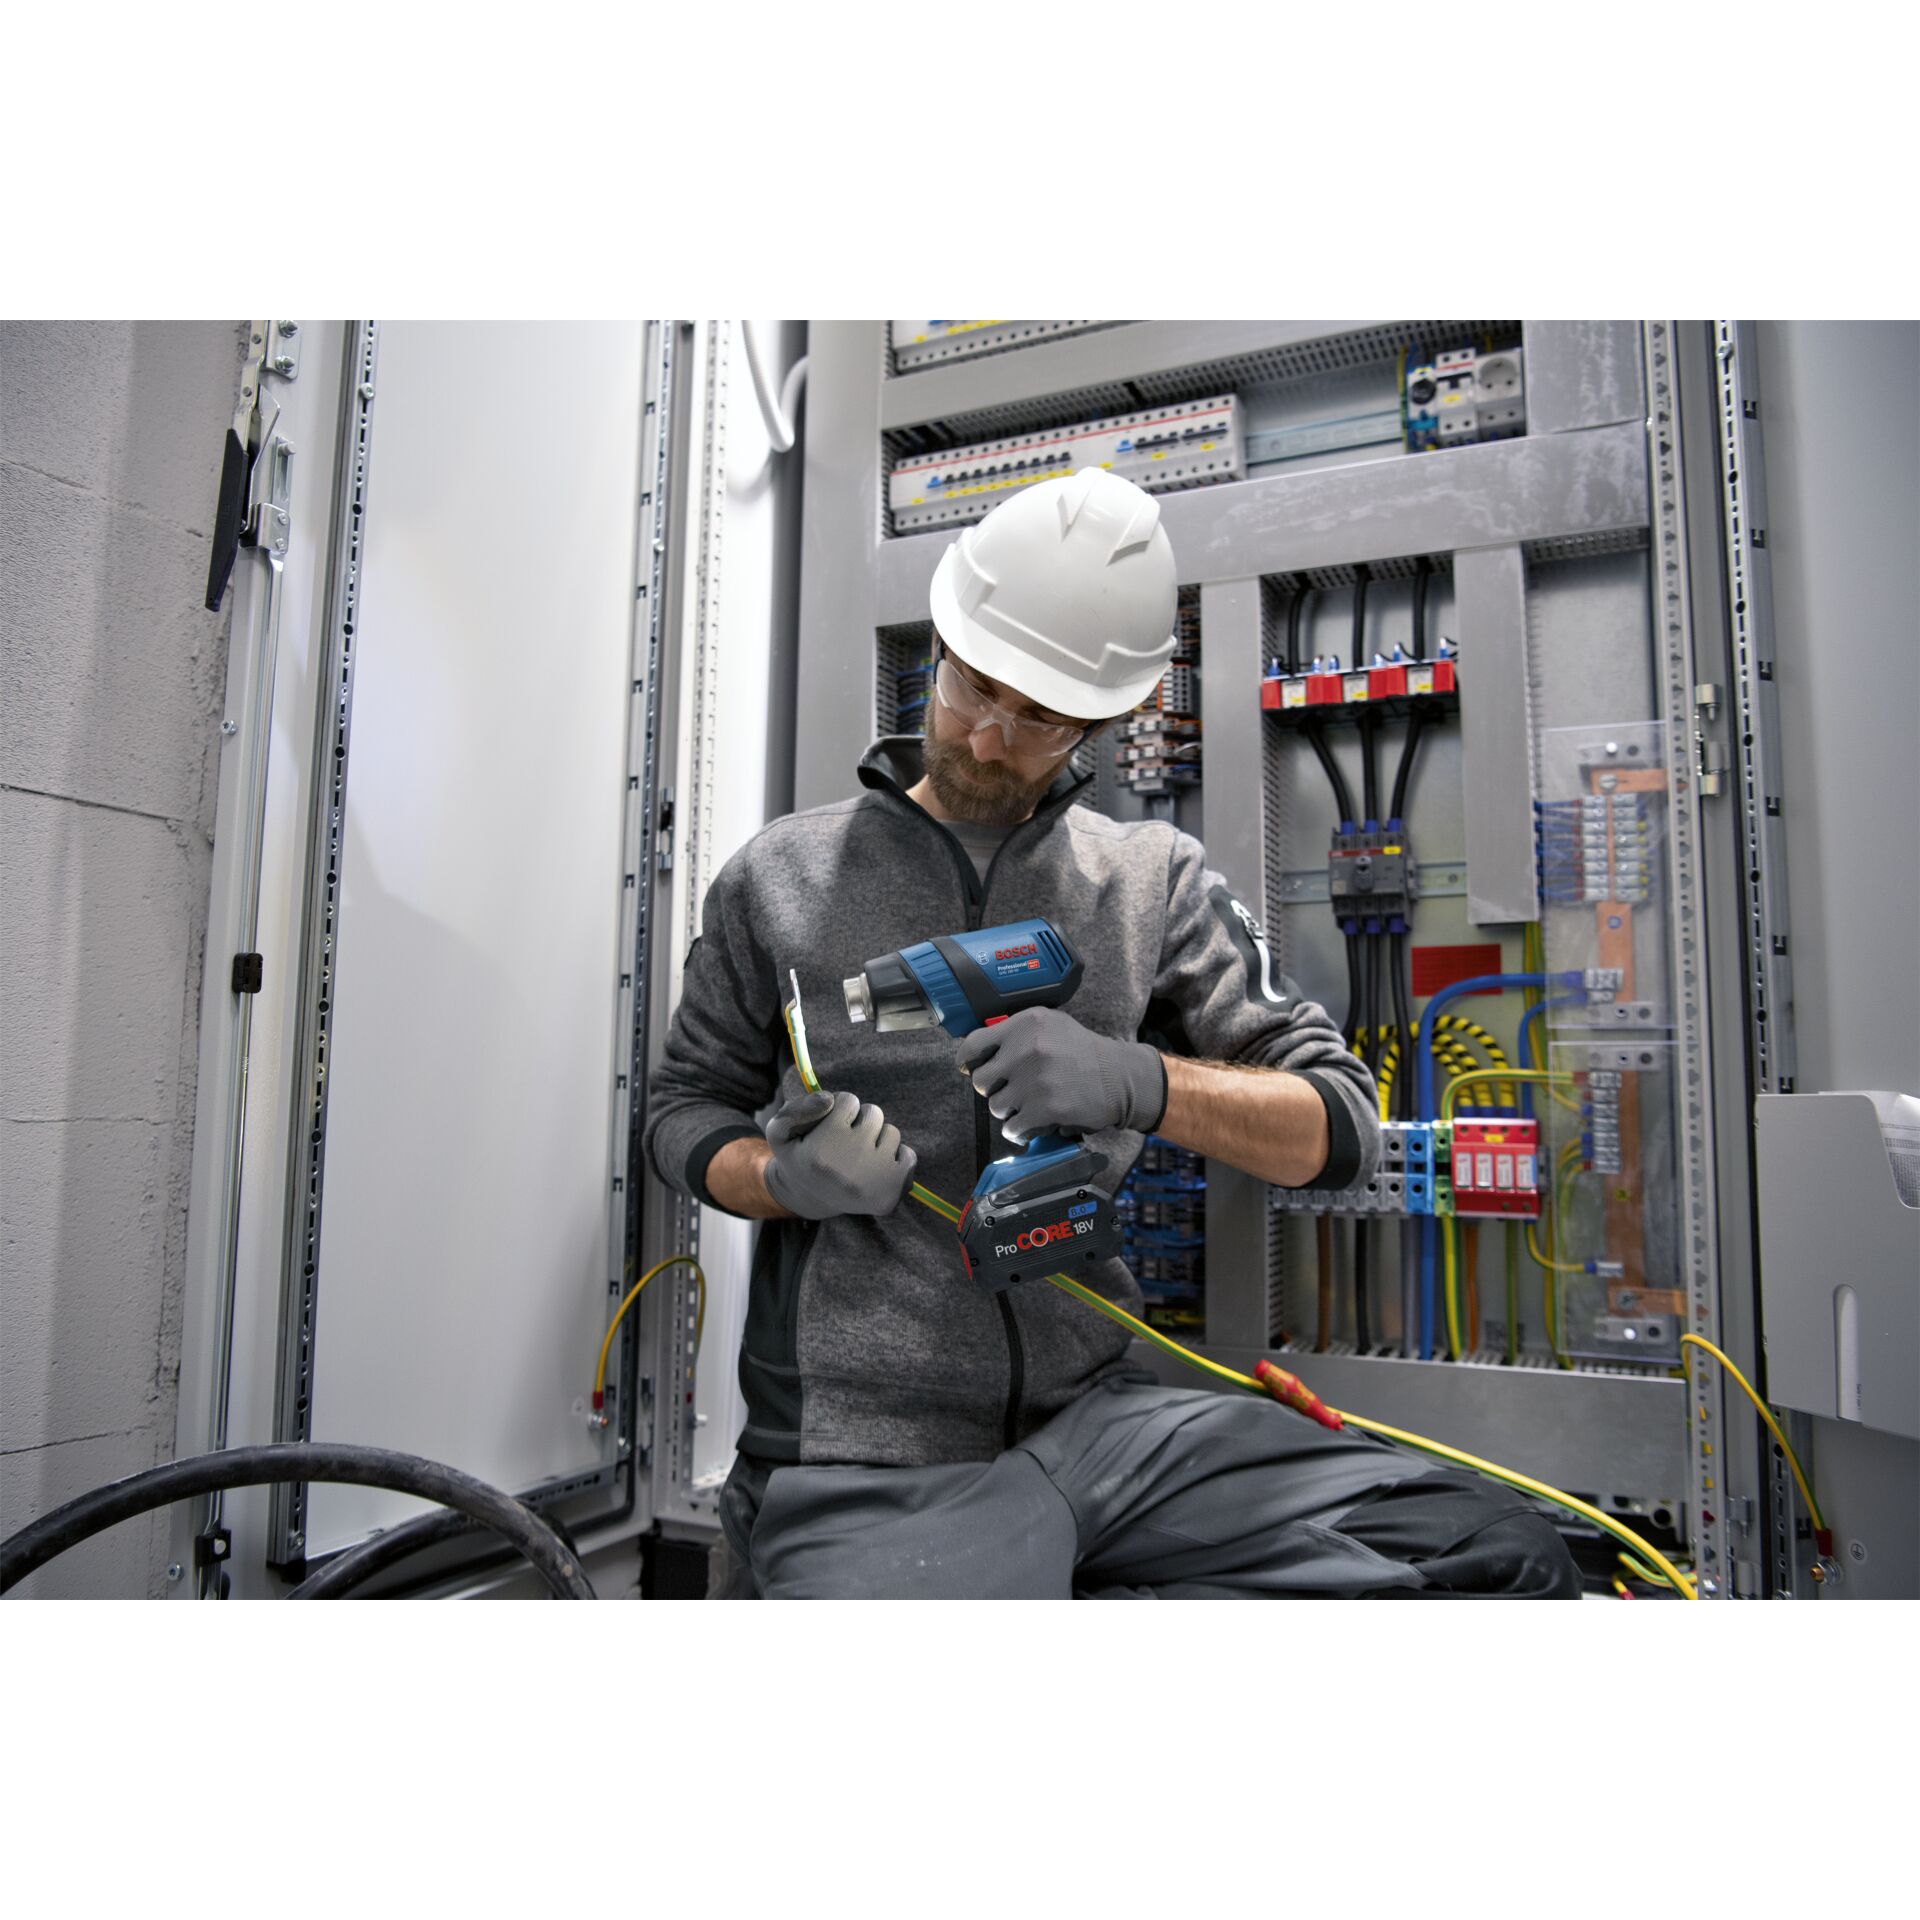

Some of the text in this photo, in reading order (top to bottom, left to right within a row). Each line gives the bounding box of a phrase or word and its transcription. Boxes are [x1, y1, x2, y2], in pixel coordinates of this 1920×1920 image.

[995, 943, 1037, 960] BOSCH
[997, 961, 1028, 971] Professional
[1073, 1219, 1094, 1235] 18V
